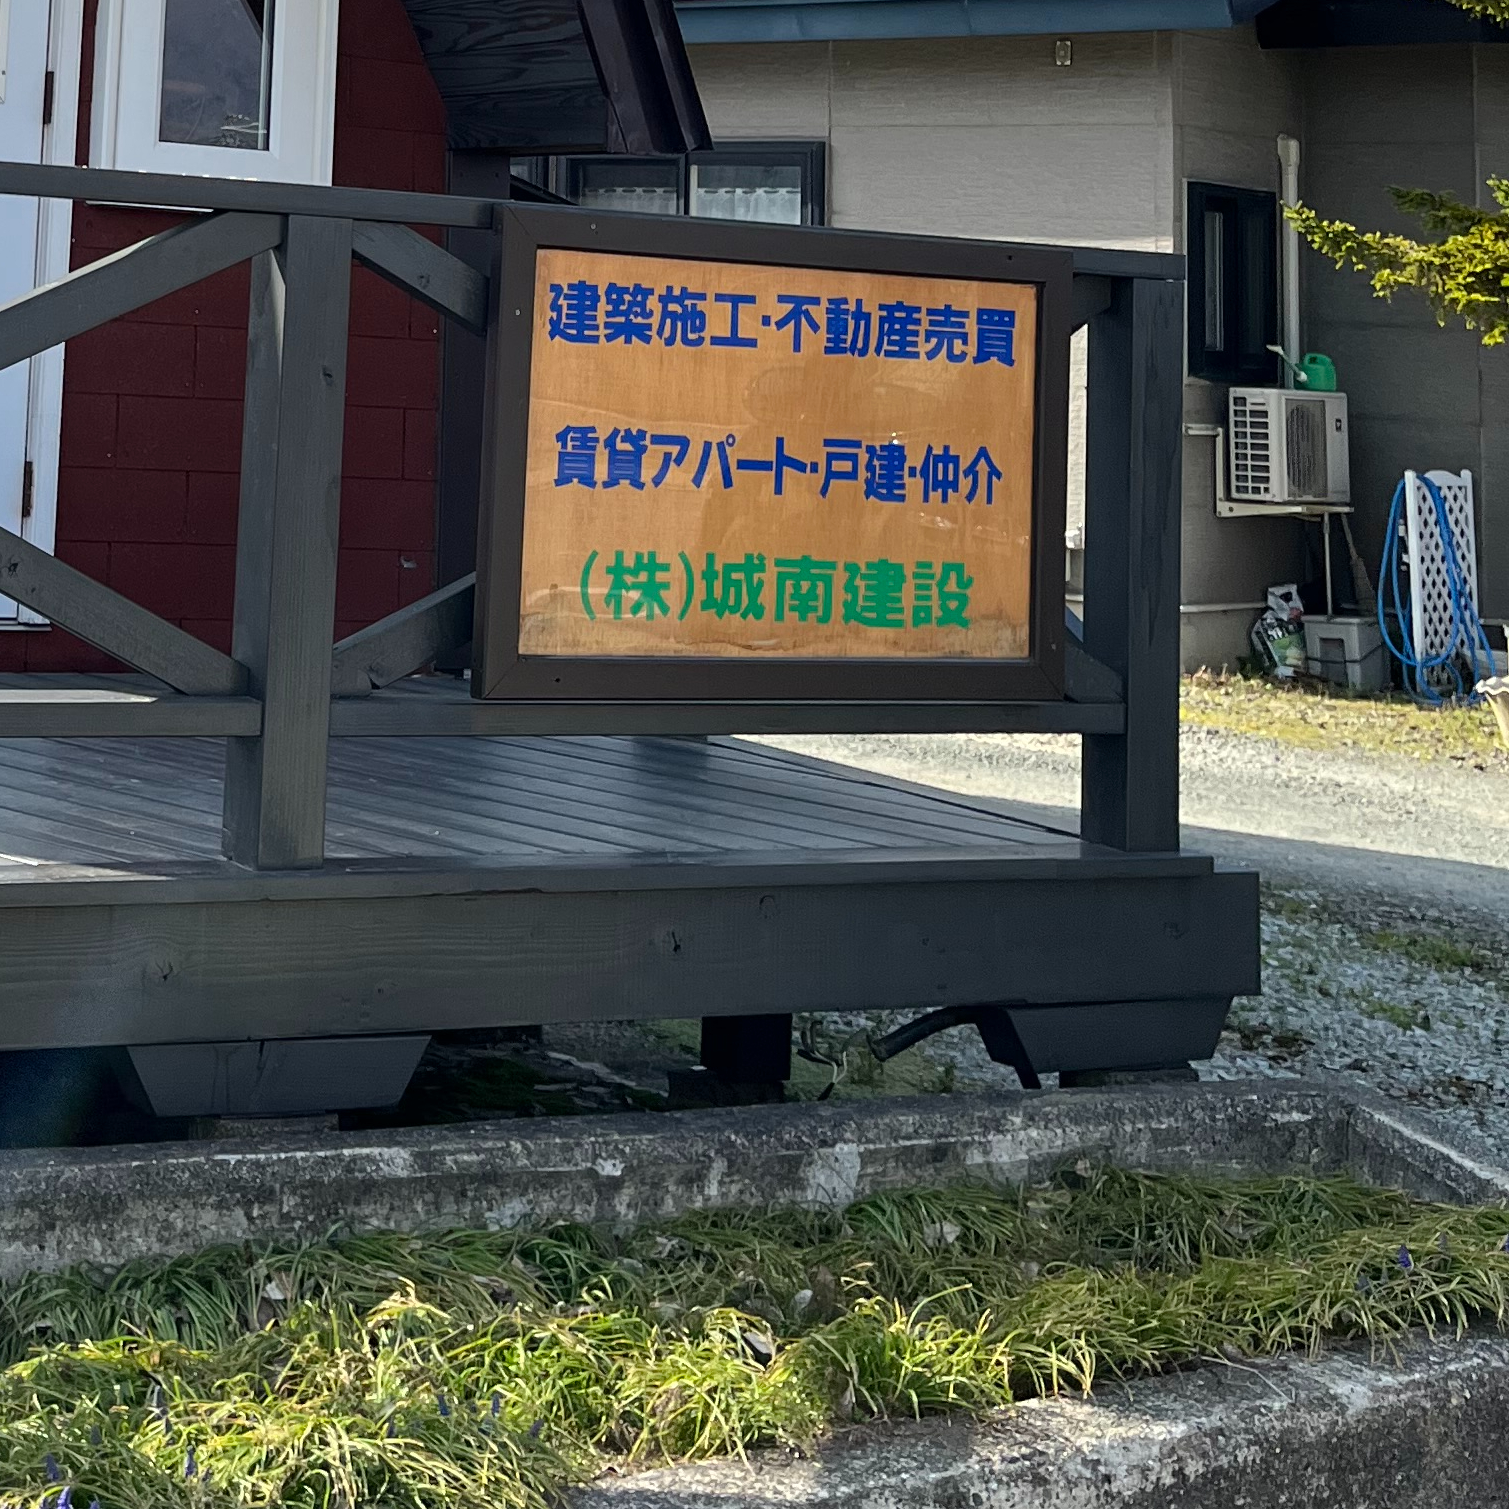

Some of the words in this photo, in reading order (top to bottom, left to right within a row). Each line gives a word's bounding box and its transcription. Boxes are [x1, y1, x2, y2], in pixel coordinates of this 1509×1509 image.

[580, 551, 974, 629] (株)城南建設
